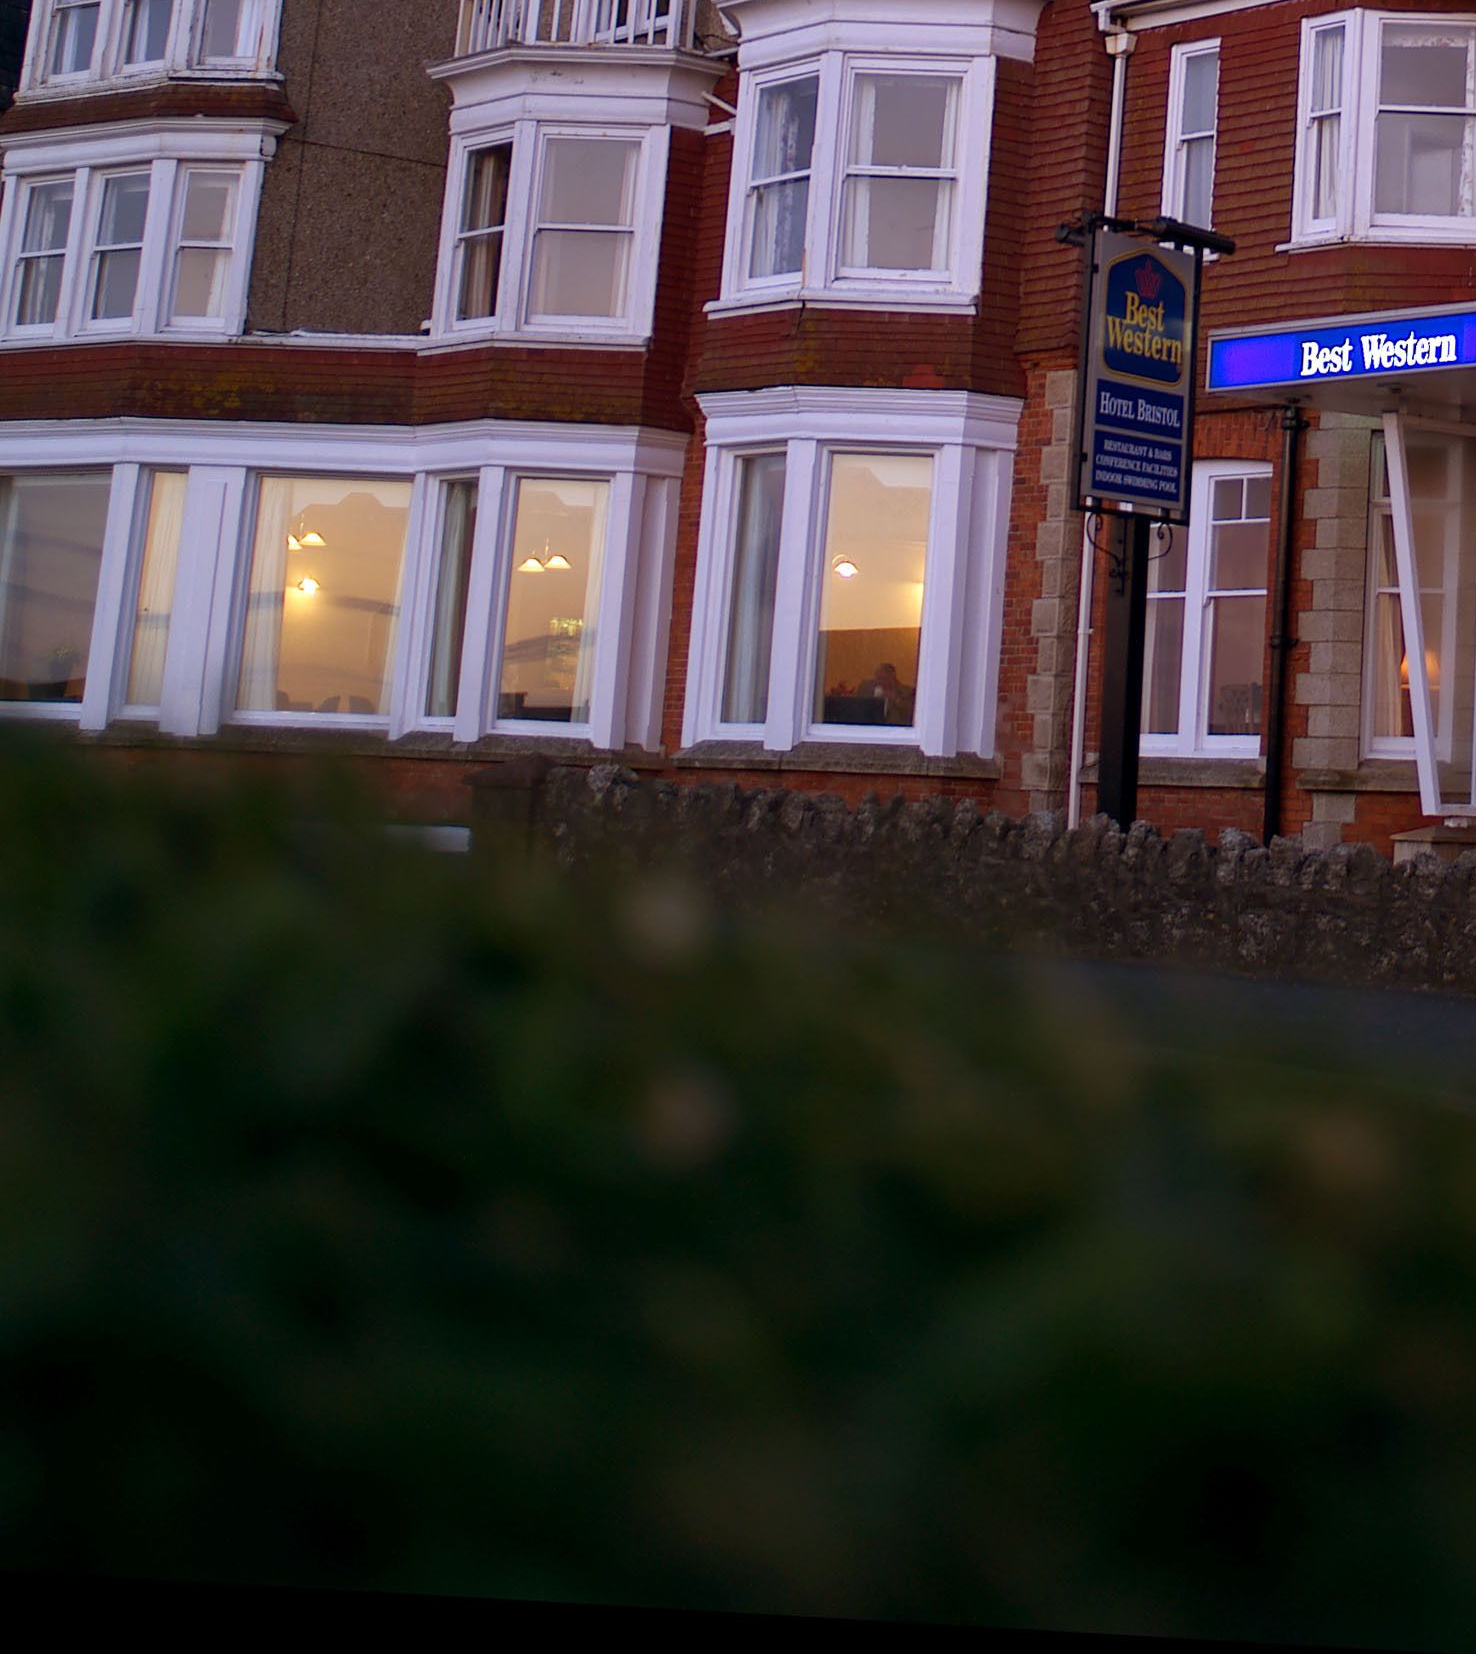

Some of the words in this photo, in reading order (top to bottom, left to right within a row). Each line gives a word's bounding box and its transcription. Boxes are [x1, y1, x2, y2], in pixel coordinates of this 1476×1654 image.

[1125, 291, 1165, 332] Best
[1106, 315, 1182, 364] Western
[1301, 338, 1353, 376] Best
[1361, 331, 1457, 370] Western
[1100, 391, 1135, 419] HOTEL
[1137, 398, 1180, 428] BRISTOL
[1095, 454, 1141, 471] CONFERENCE
[1095, 470, 1122, 484] INDOOR
[1159, 480, 1177, 494] POOL
